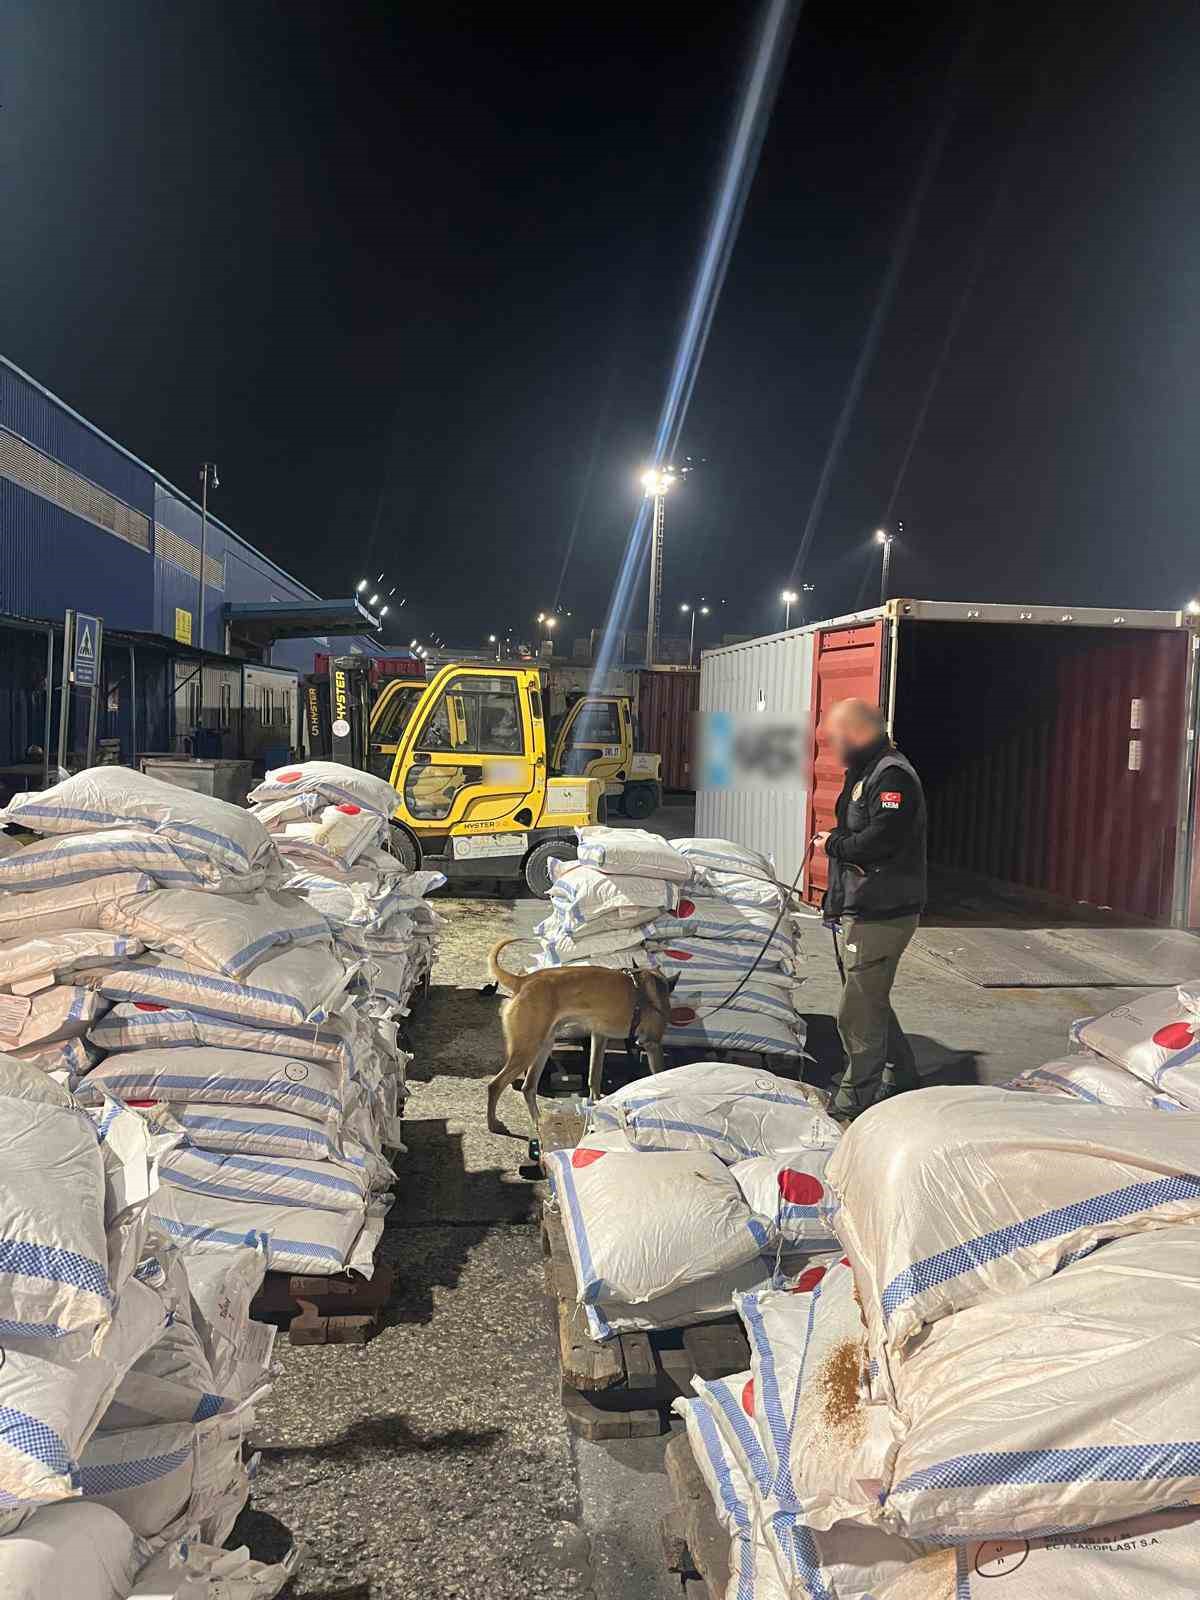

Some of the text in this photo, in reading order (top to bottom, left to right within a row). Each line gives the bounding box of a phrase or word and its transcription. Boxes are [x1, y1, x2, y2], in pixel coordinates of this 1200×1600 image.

[308, 687, 319, 724] HYSTER
[335, 671, 346, 720] HYSTER
[464, 821, 495, 830] HYSTER
